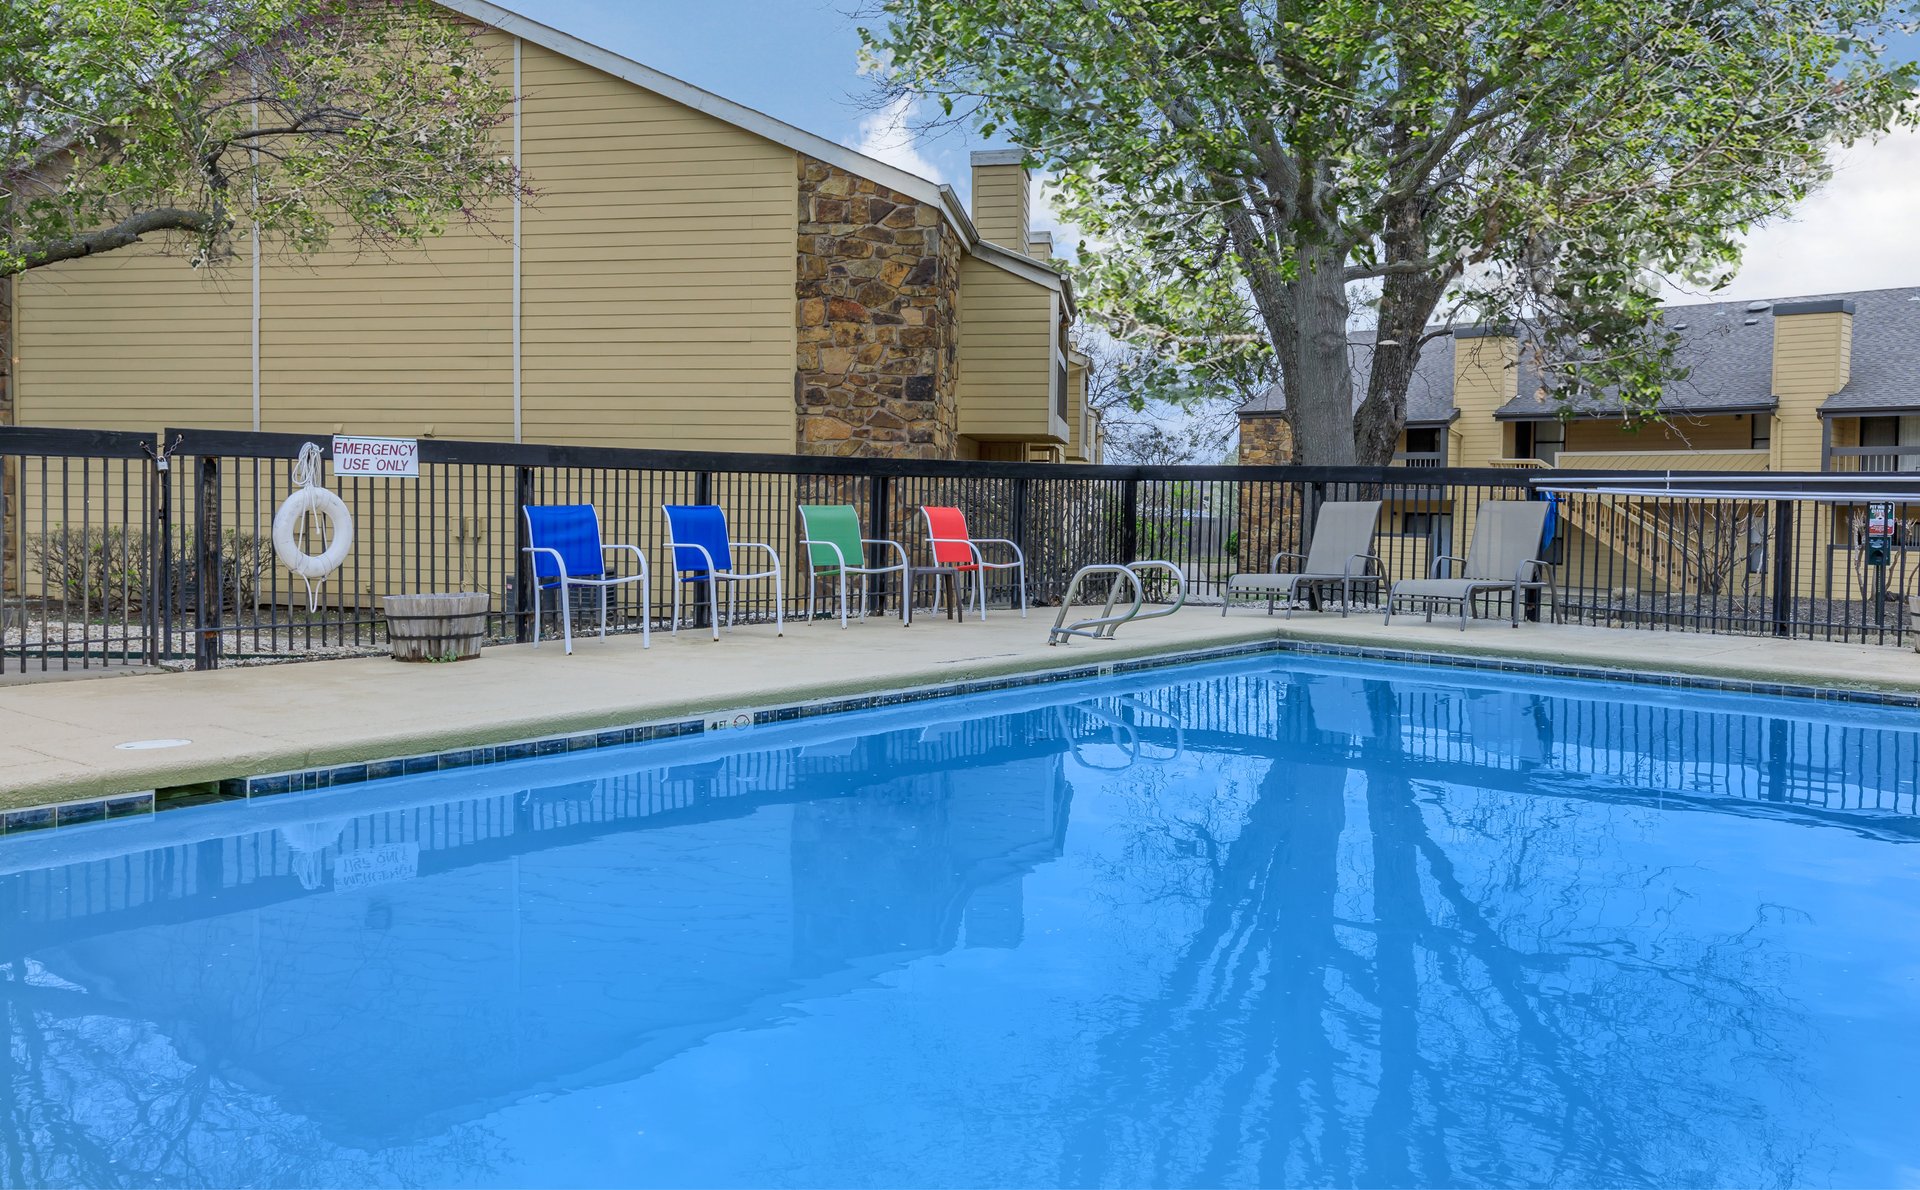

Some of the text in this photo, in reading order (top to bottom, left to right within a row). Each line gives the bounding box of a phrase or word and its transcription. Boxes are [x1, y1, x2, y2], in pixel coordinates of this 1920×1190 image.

[334, 442, 416, 456] EMERGENCY
[343, 458, 409, 472] USE ONLY
